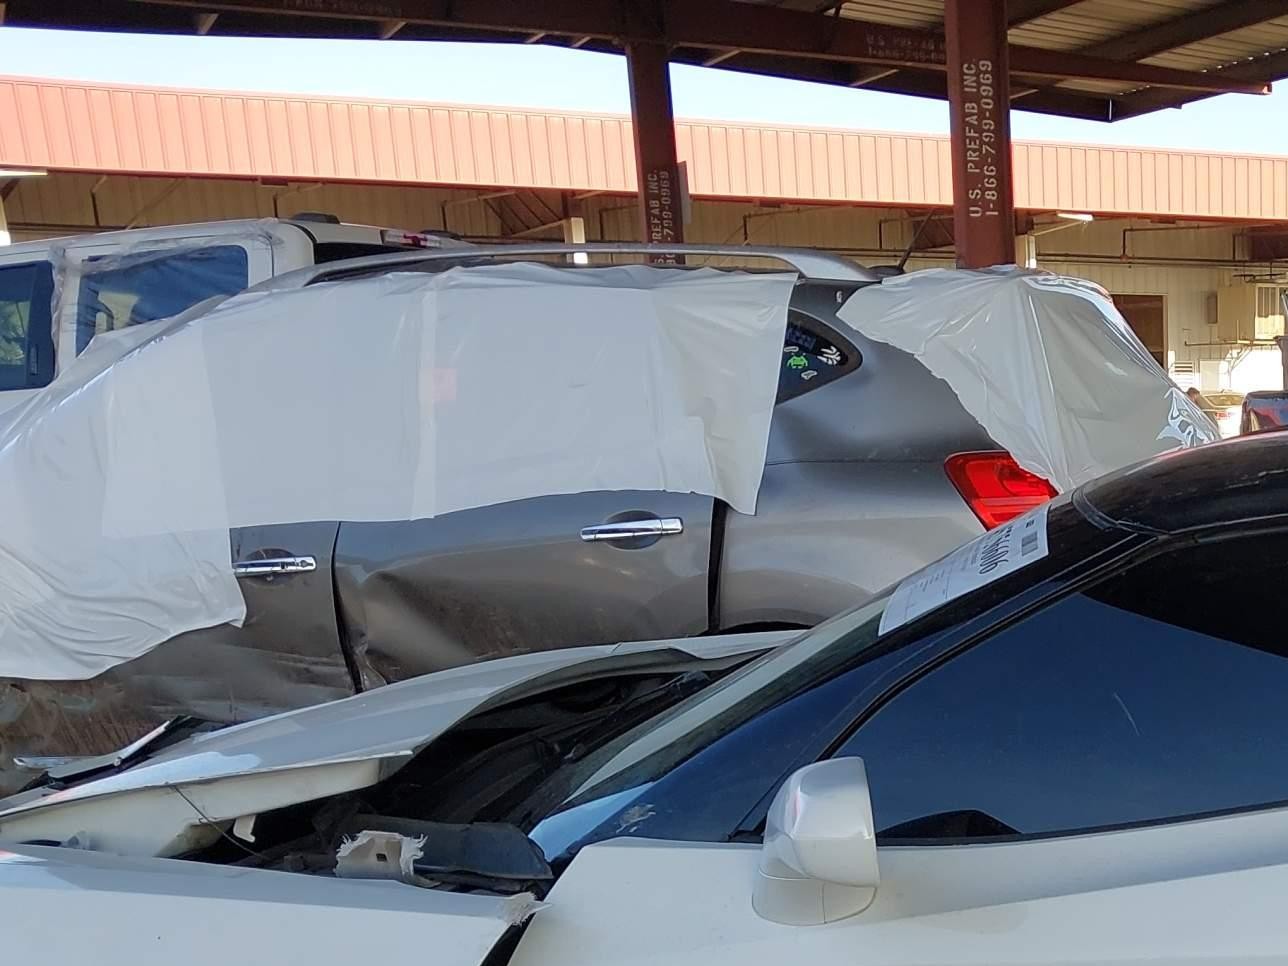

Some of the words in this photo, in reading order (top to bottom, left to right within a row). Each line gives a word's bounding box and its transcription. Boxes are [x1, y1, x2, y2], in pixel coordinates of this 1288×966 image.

[963, 58, 978, 92] INC.
[964, 102, 981, 172] PREFAB
[978, 59, 999, 216] 1-866-799-0969
[647, 169, 659, 193] INC.
[968, 183, 982, 217] U.S.
